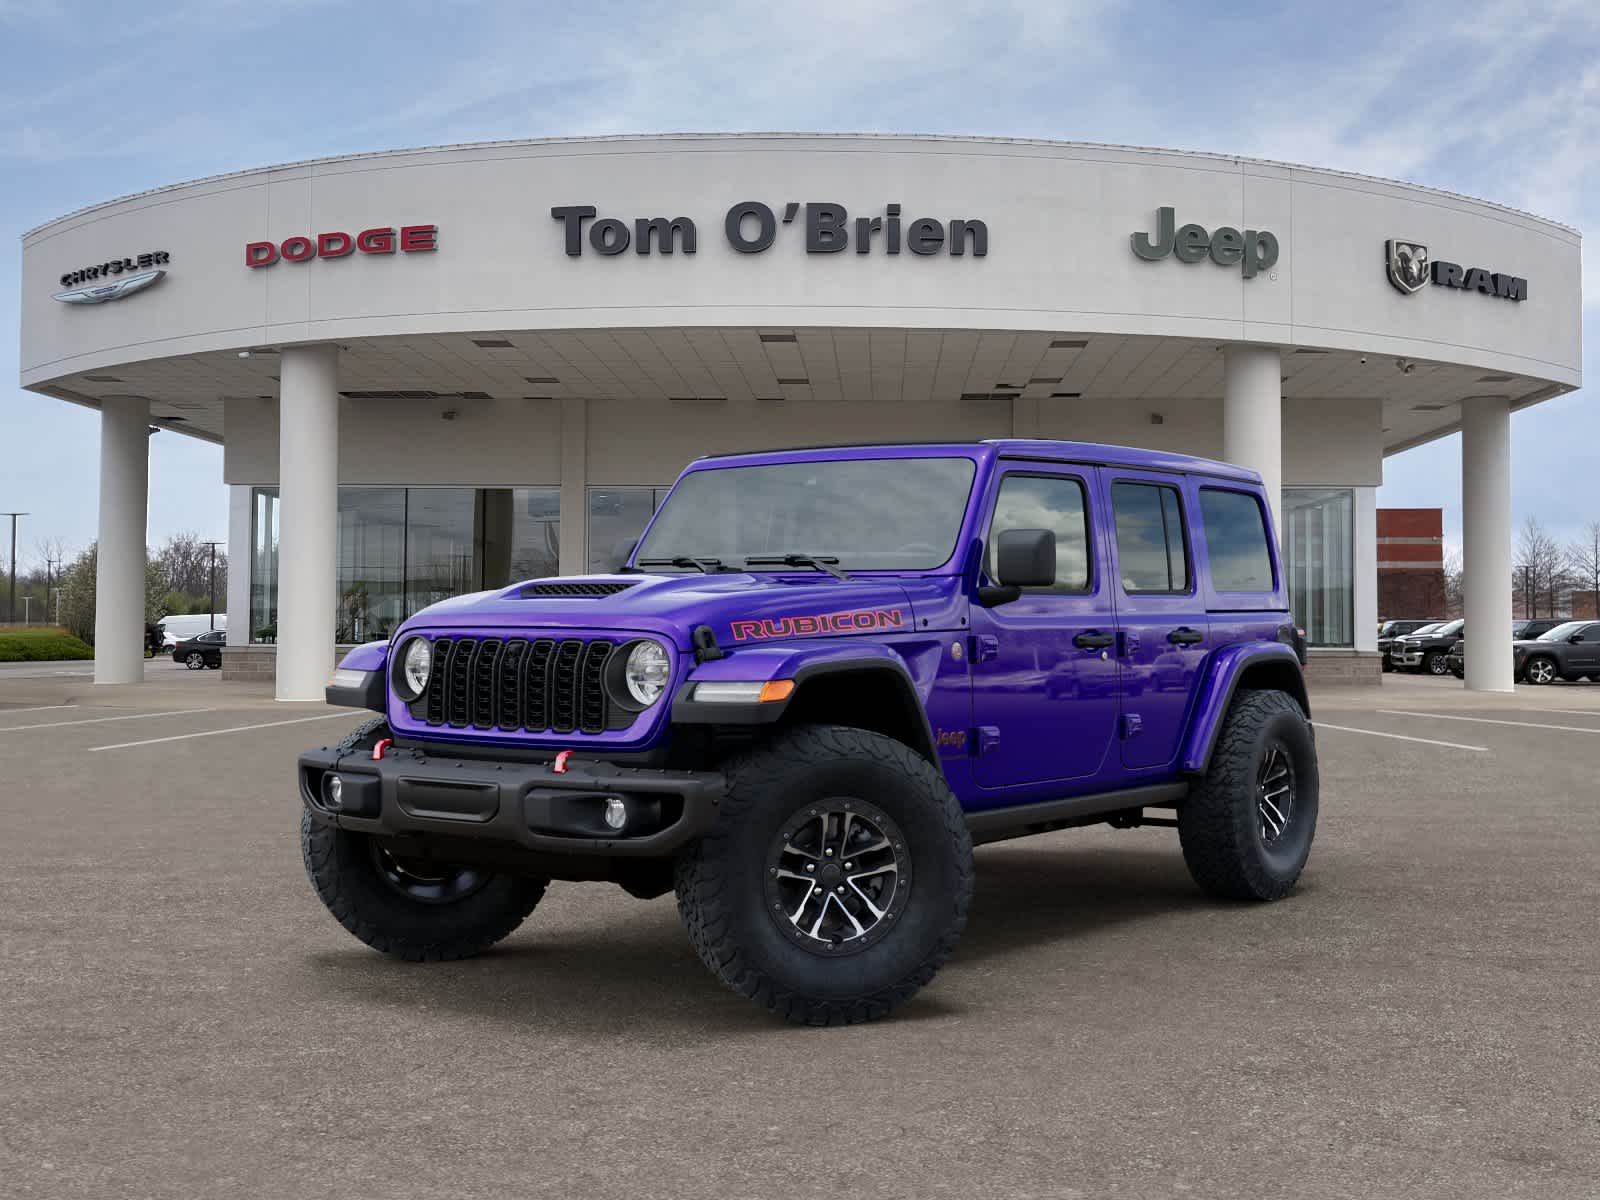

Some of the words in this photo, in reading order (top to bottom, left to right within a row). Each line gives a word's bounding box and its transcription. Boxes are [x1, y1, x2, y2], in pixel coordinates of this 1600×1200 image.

[245, 224, 438, 268] DODGE
[551, 205, 697, 256] Tom
[1130, 206, 1279, 279] Jeep
[60, 250, 170, 287] CHRYSLER
[1431, 260, 1528, 302] RAM
[731, 608, 903, 640] RUBICON
